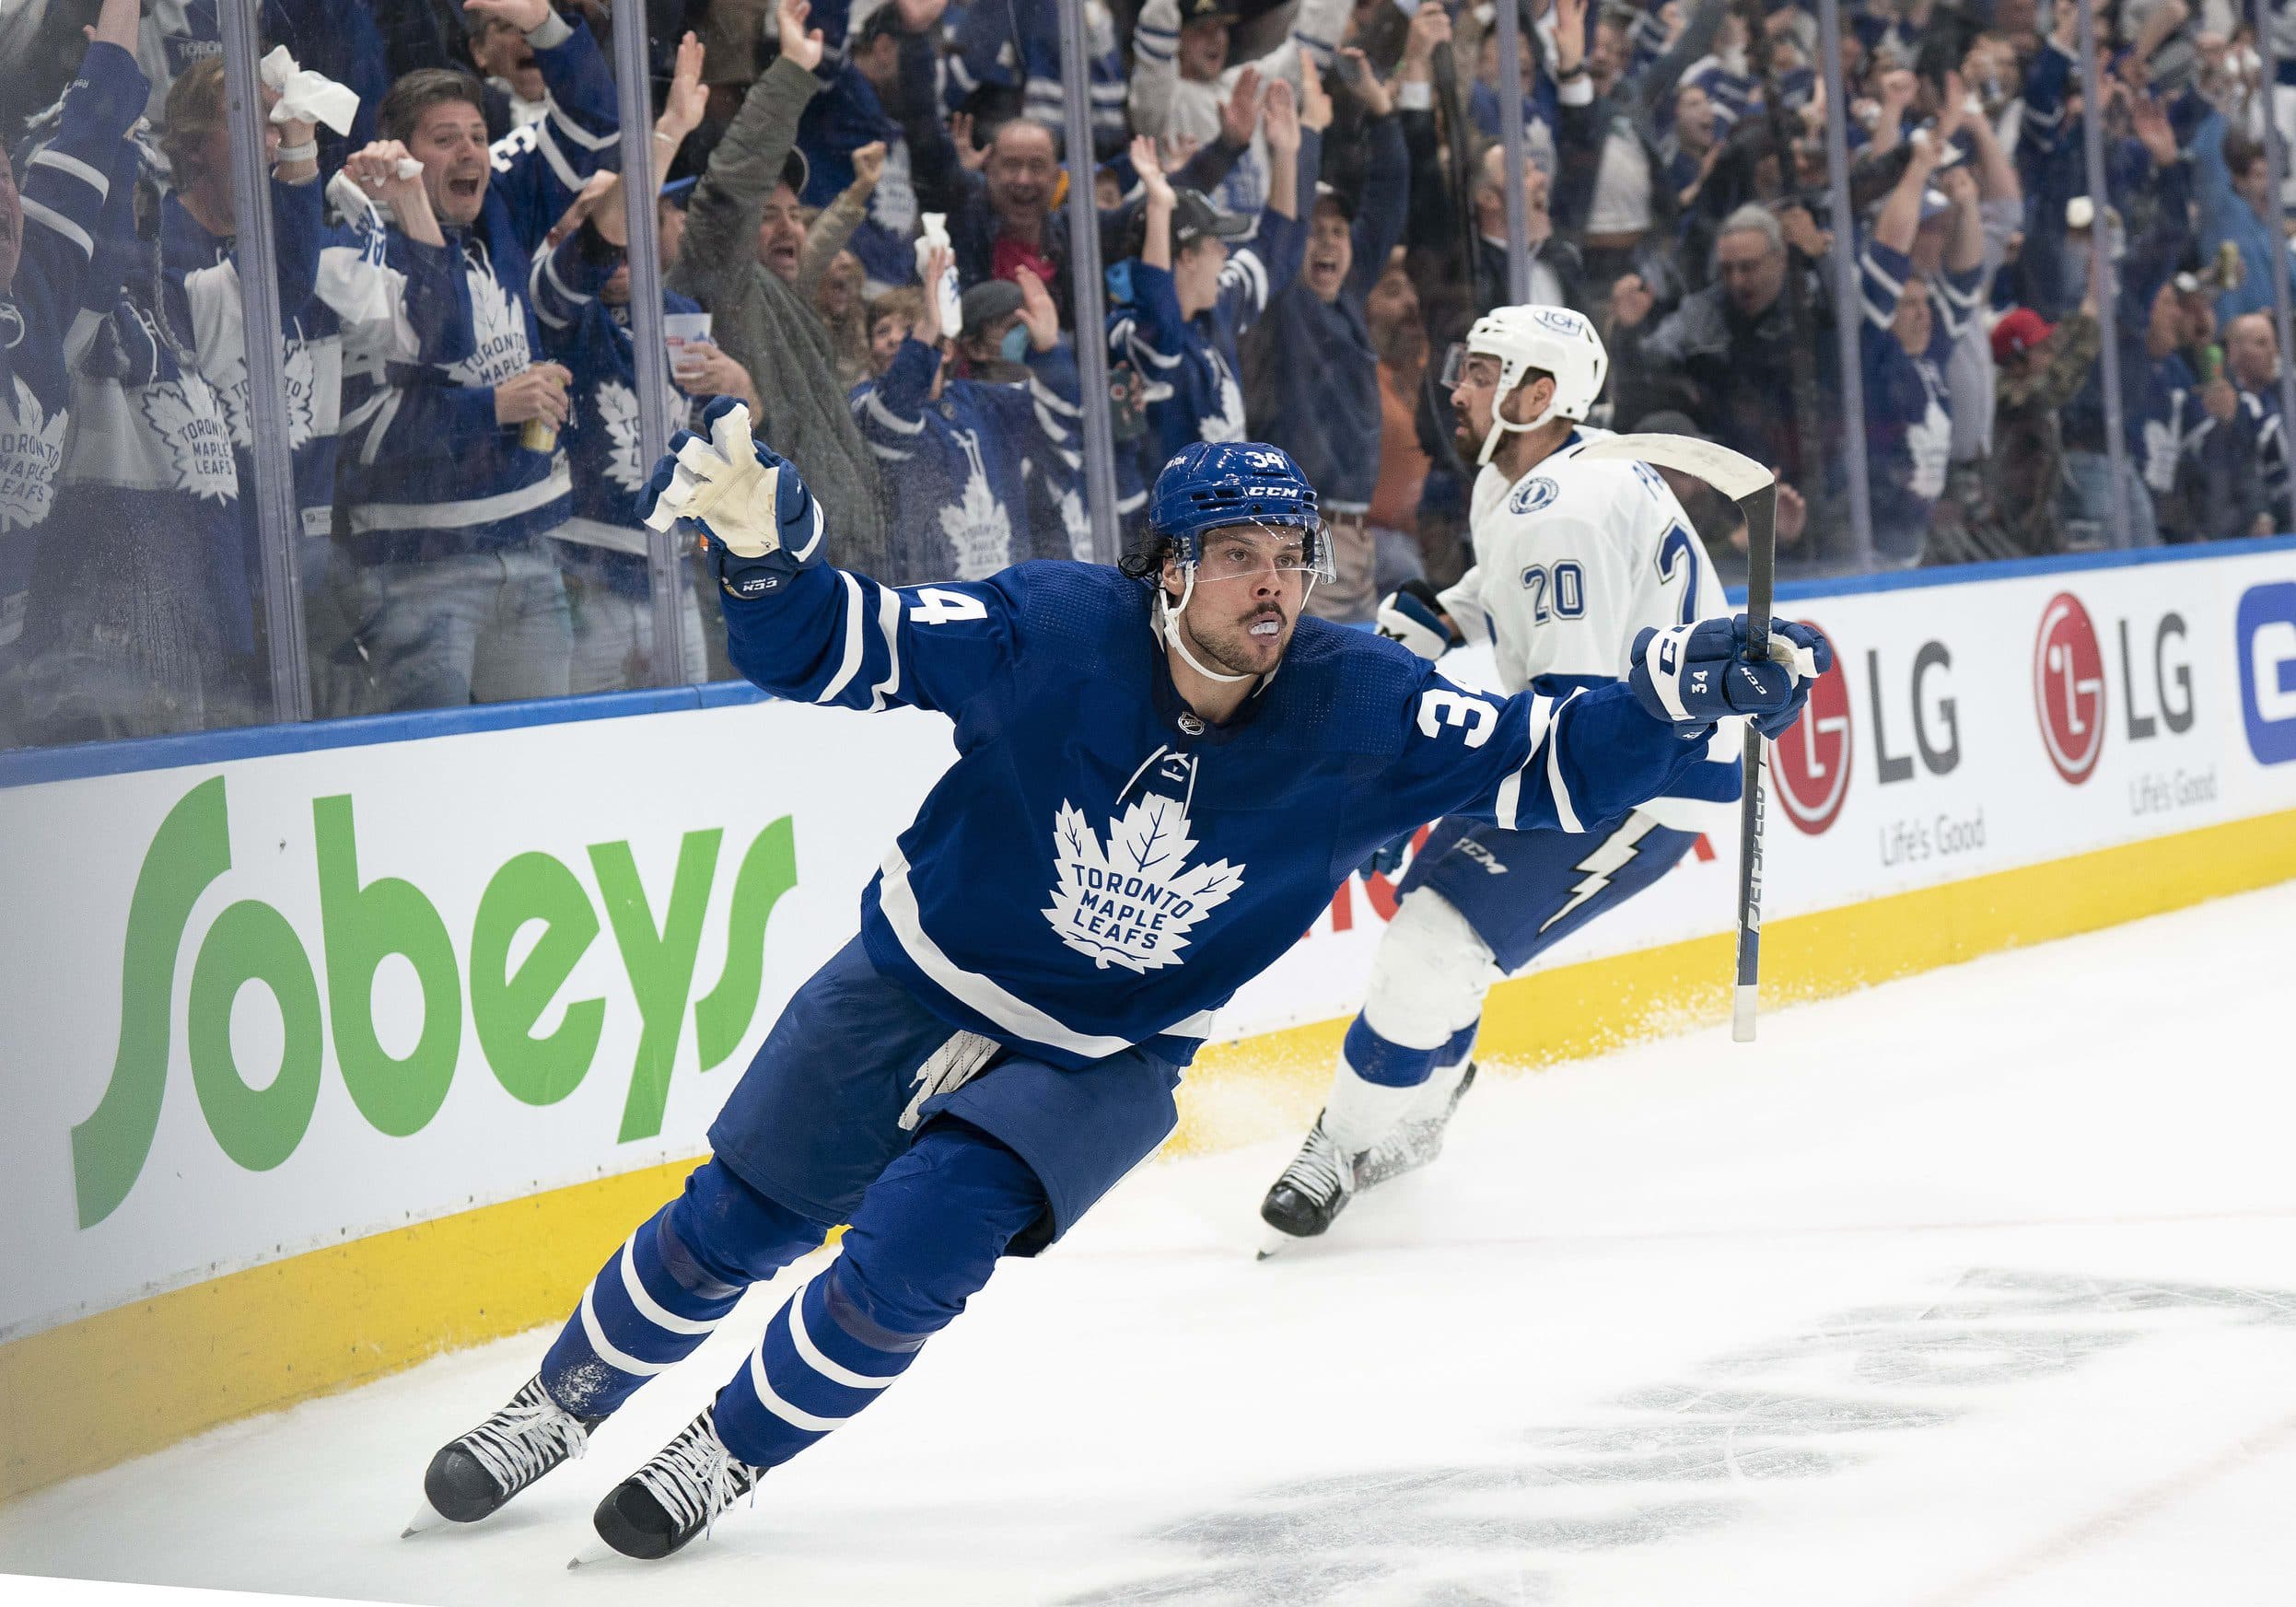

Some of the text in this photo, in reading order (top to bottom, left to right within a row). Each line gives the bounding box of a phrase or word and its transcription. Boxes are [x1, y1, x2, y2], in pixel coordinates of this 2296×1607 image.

[460, 332, 526, 373] TORONTO
[480, 352, 524, 384] MAPLE
[192, 440, 229, 458] MAPLE
[194, 459, 232, 475] LEAFS
[1245, 451, 1286, 469] 34
[1248, 486, 1299, 497] CCM
[742, 579, 778, 592] CCM
[1520, 558, 1588, 628] 20
[909, 588, 988, 625] 4
[1691, 669, 1709, 695] 34
[1740, 665, 1768, 696] CCM
[2118, 611, 2196, 741] LG
[1866, 639, 1961, 785] LG
[1748, 786, 1766, 925] JETSPEED
[1878, 802, 1986, 868] Life's Good
[1072, 863, 1194, 919] TORONTO
[1079, 890, 1167, 932] MAPLE
[1073, 908, 1159, 950] LEAFS
[71, 774, 798, 1230] Sobeys
